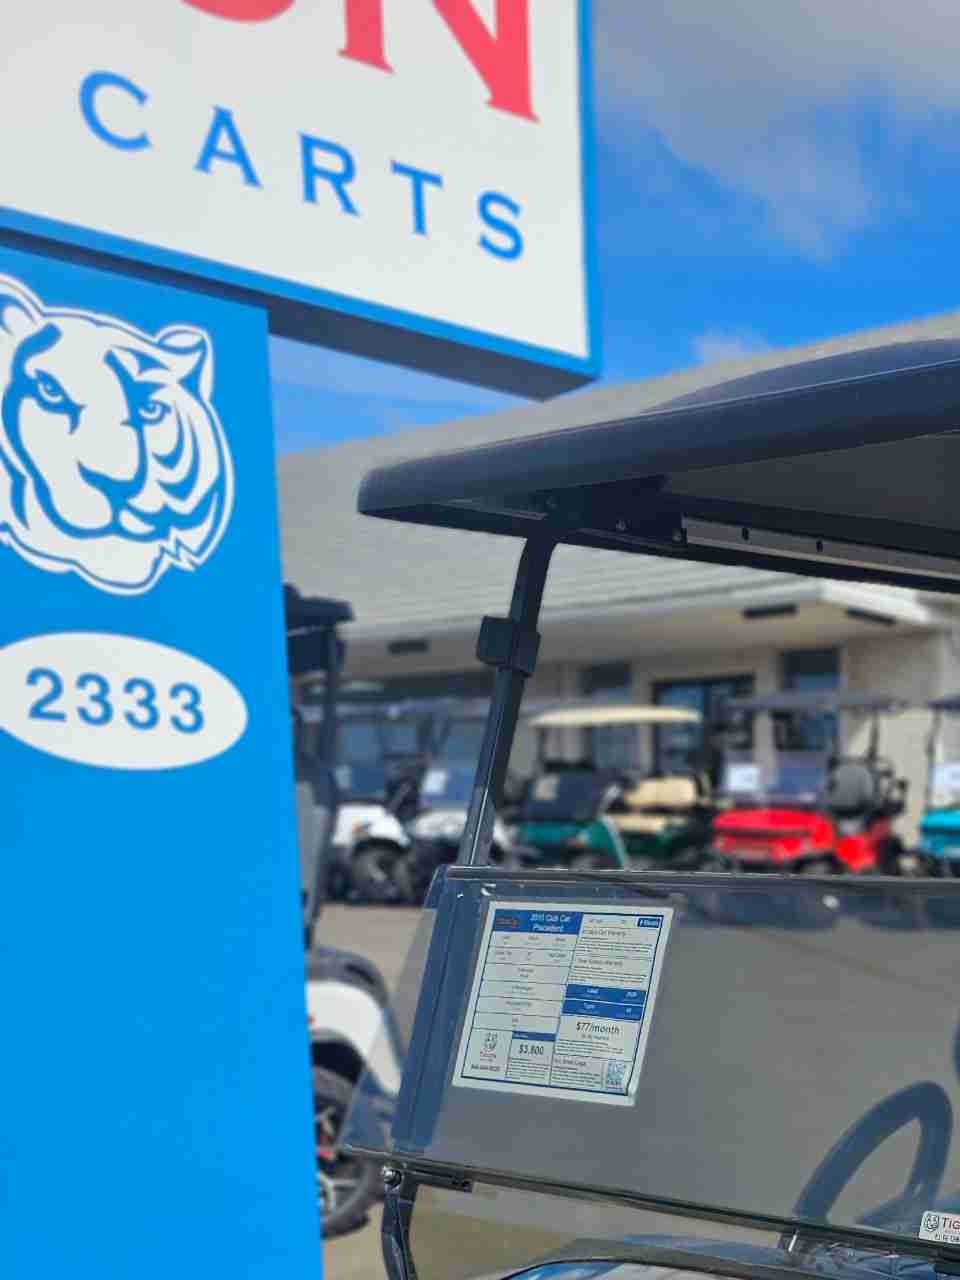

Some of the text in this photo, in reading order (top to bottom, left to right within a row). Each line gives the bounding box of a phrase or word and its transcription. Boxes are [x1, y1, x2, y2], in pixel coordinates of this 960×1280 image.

[77, 69, 524, 262] CARTS
[24, 667, 205, 734] 2333
[576, 1022, 620, 1034] $77/month
